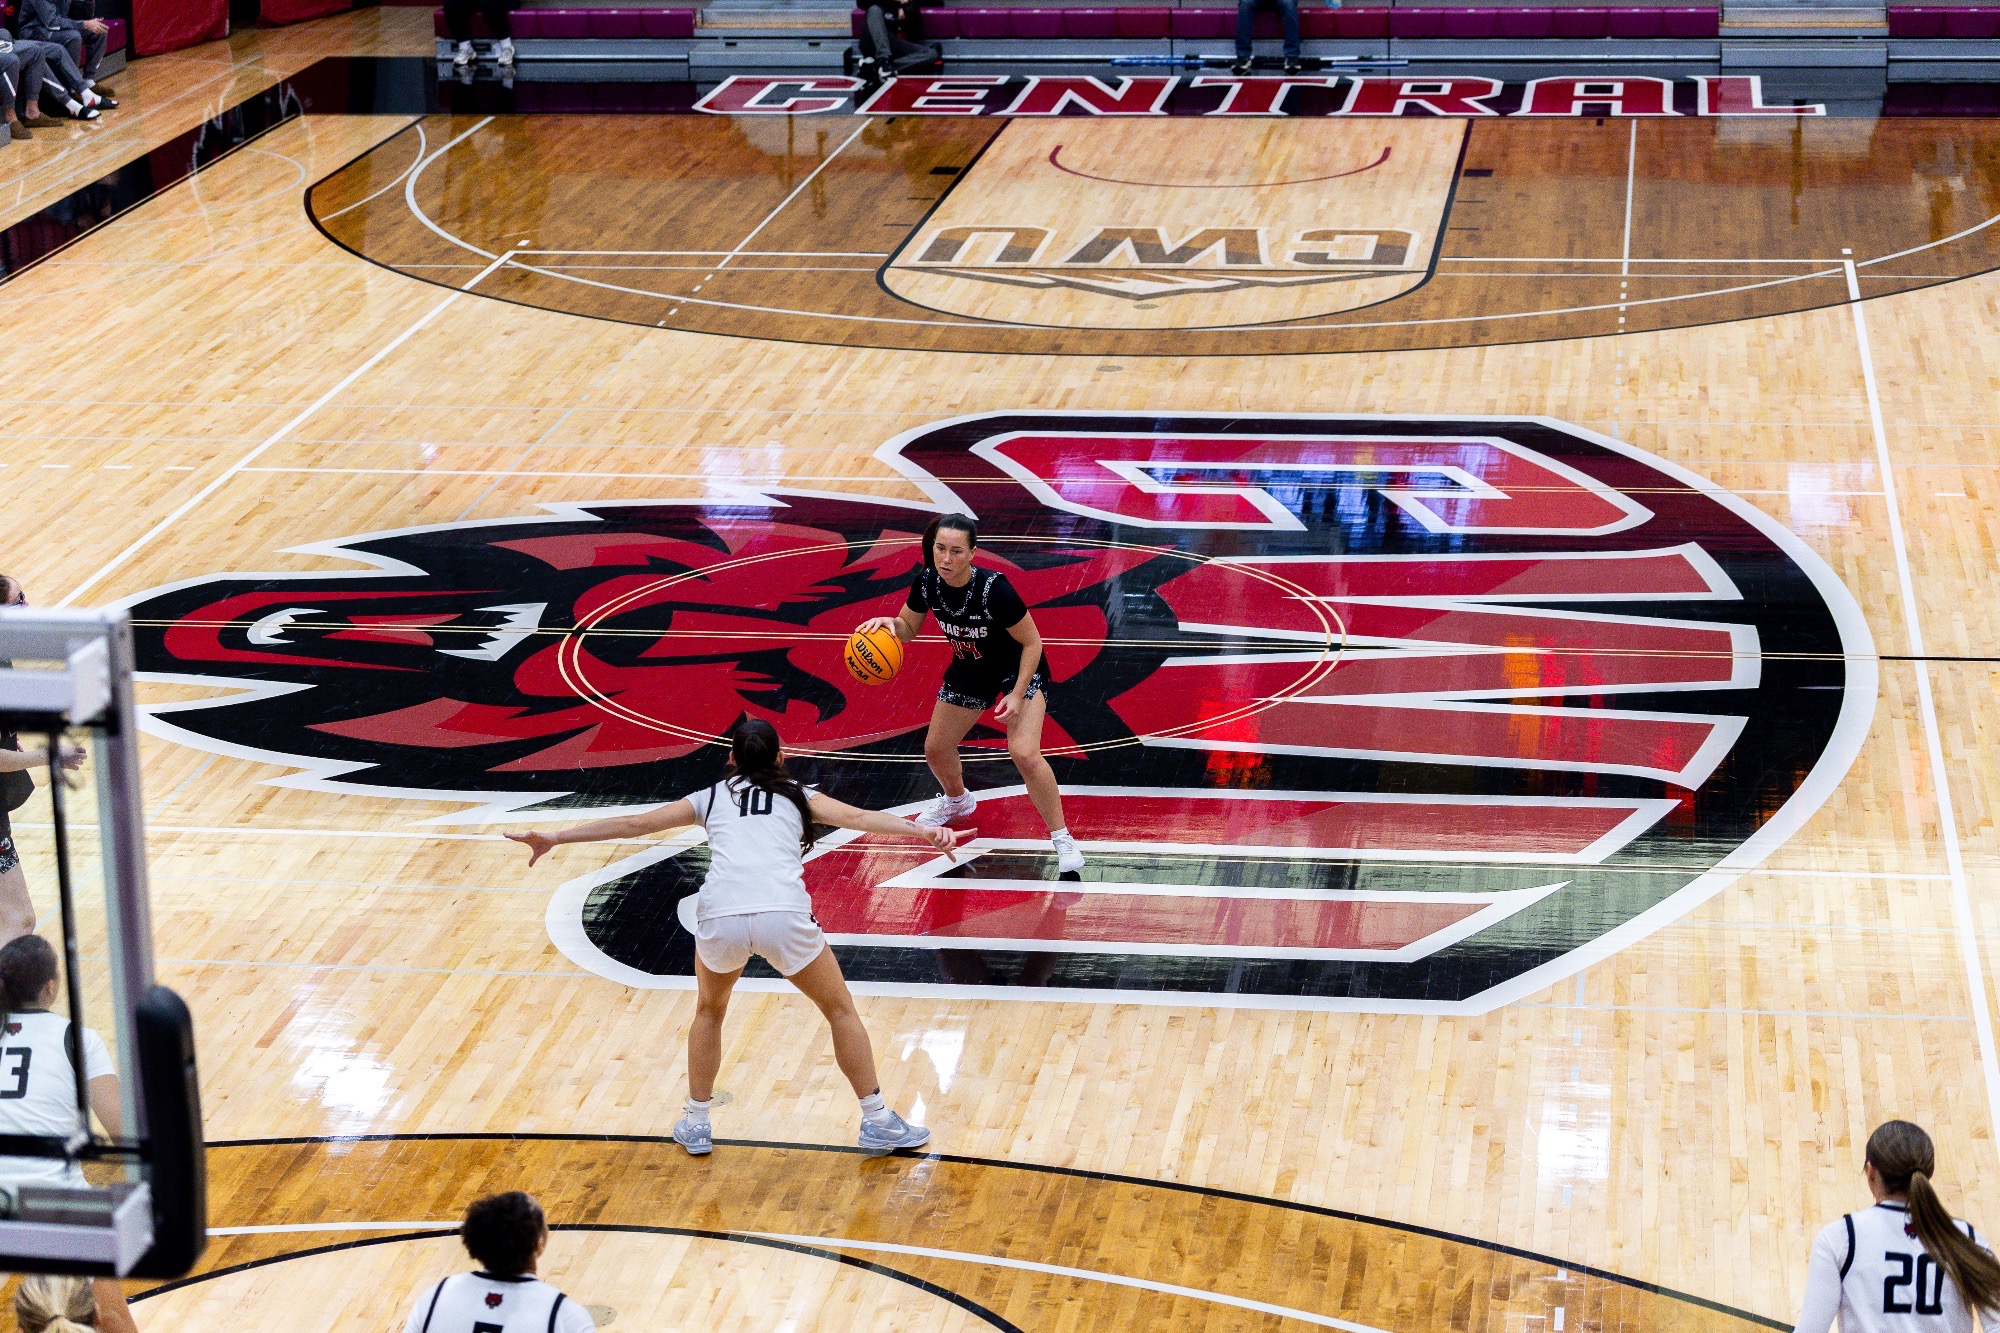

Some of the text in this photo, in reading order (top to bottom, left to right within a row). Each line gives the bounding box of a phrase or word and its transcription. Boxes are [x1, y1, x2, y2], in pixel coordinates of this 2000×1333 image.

[692, 75, 1827, 116] CENTRAL
[908, 226, 1421, 266] CWU
[847, 656, 869, 680] NCAA
[856, 639, 883, 674] Wilson
[950, 639, 983, 660] 14
[738, 787, 774, 817] 10
[0, 1046, 32, 1099] 3
[1883, 1251, 1944, 1316] 20
